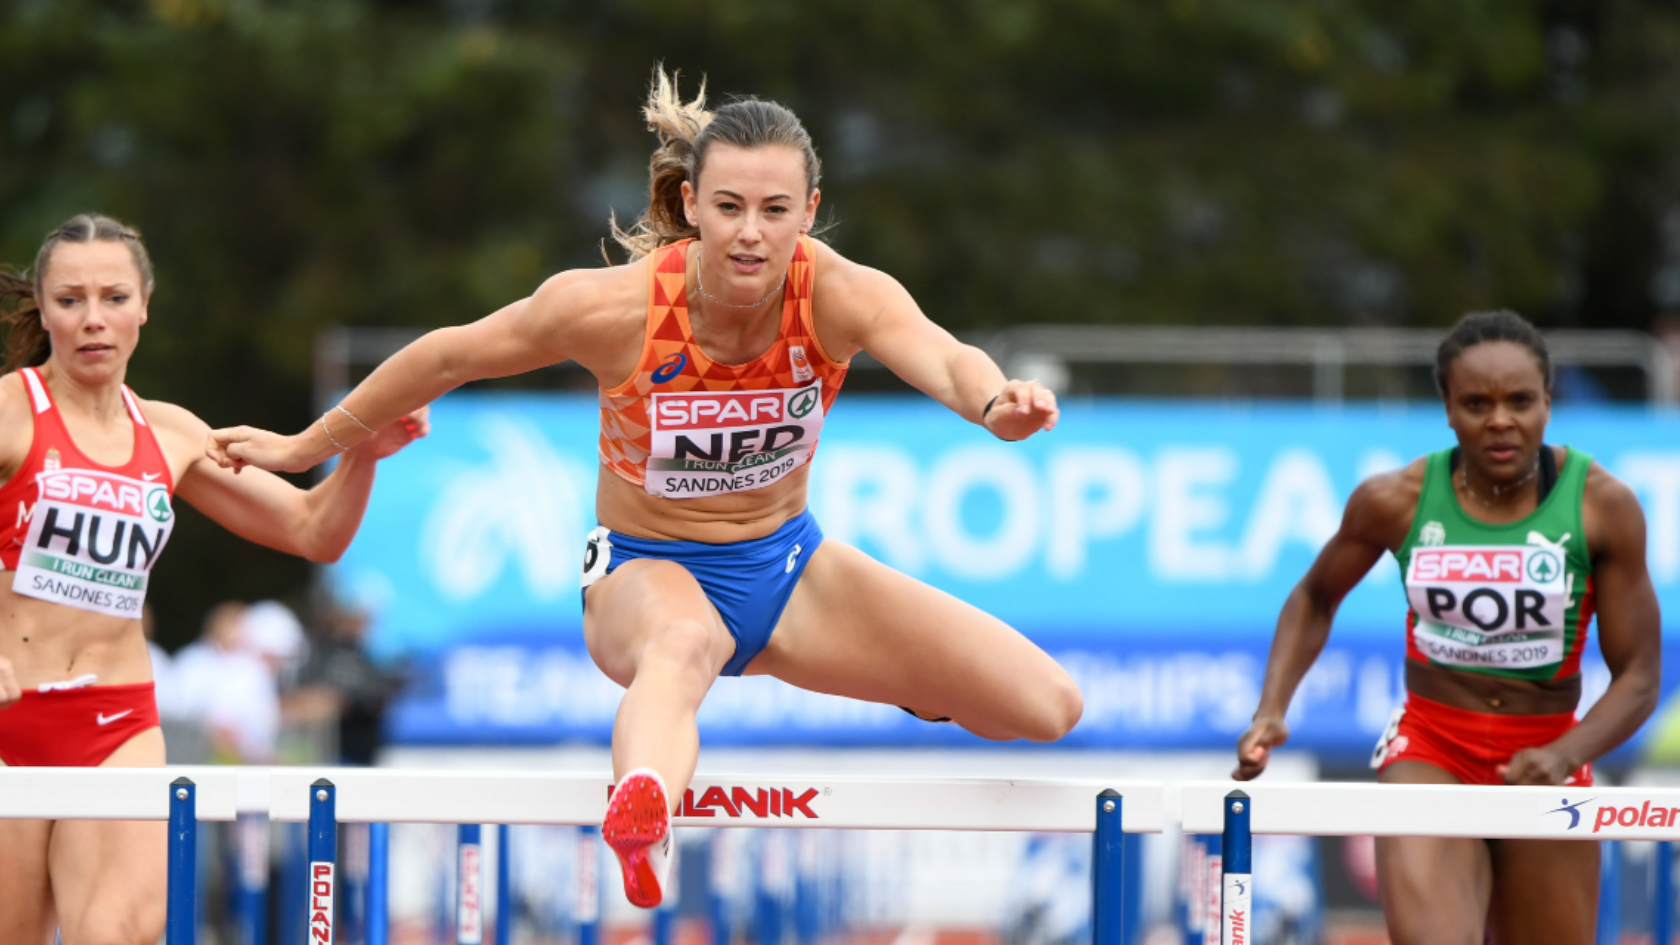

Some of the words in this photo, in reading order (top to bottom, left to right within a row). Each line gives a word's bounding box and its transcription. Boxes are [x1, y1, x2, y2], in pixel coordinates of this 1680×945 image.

[658, 397, 780, 425] SPAR
[674, 425, 805, 463] NED
[665, 474, 754, 493] SANDNES
[759, 457, 795, 484] 2019
[693, 460, 728, 471] RUN
[46, 474, 141, 514] SPAR
[820, 446, 1404, 585] ROPEA
[37, 506, 165, 571] HUN
[52, 559, 59, 571] I
[61, 561, 94, 580] RUN
[95, 569, 136, 588] CLEAN
[1416, 553, 1521, 580] SPAR
[32, 575, 113, 608] SANDNES
[1426, 587, 1552, 632] POR
[1428, 642, 1507, 663] SANDNES
[1511, 645, 1549, 663] 2019
[607, 784, 820, 819] LANIK
[311, 864, 332, 945] POLAN
